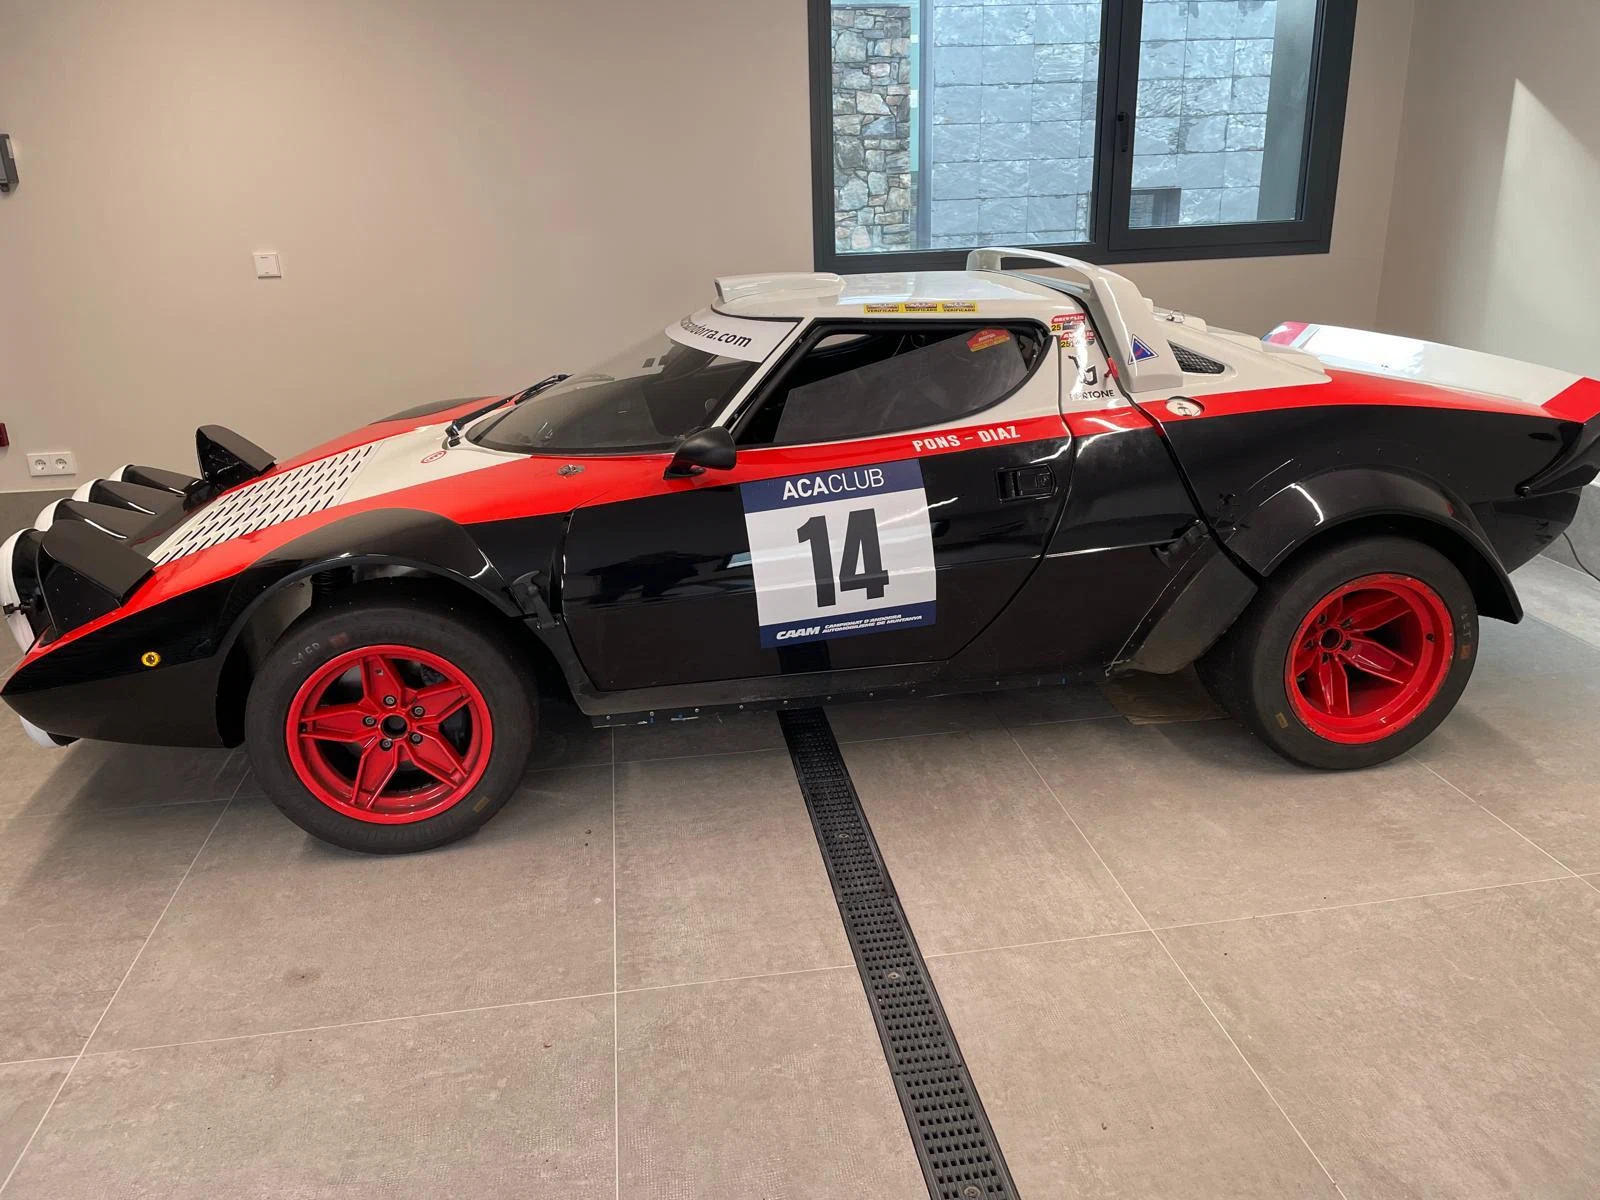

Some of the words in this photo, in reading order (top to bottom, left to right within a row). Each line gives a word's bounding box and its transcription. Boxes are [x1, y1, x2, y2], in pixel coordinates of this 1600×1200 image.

[912, 434, 961, 453] PONS
[977, 425, 1021, 443] DIAZ
[782, 468, 885, 501] ACACLUB
[796, 508, 890, 608] 14
[776, 626, 821, 640] CAAM
